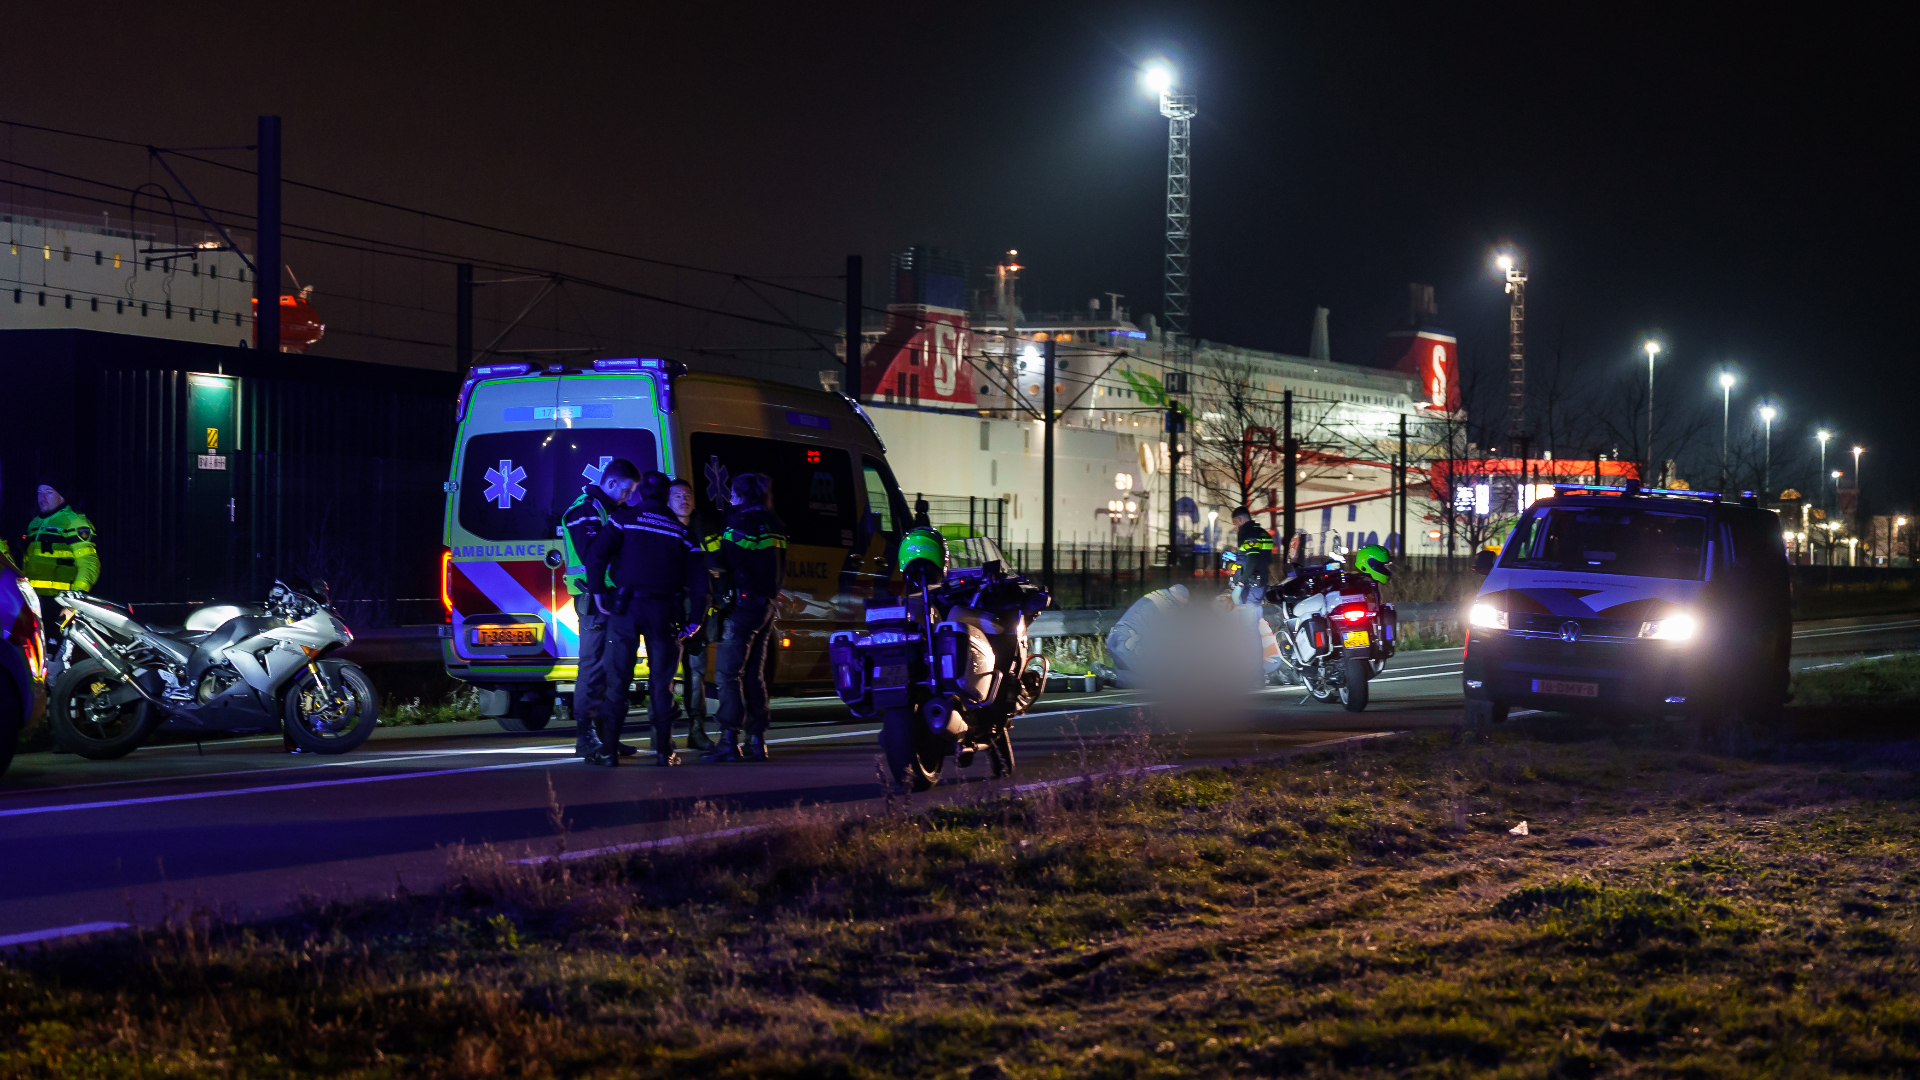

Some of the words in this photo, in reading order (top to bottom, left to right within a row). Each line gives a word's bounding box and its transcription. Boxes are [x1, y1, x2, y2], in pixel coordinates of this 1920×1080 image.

[1168, 374, 1179, 391] H
[1432, 344, 1447, 407] S
[452, 544, 545, 558] AMBULANCE
